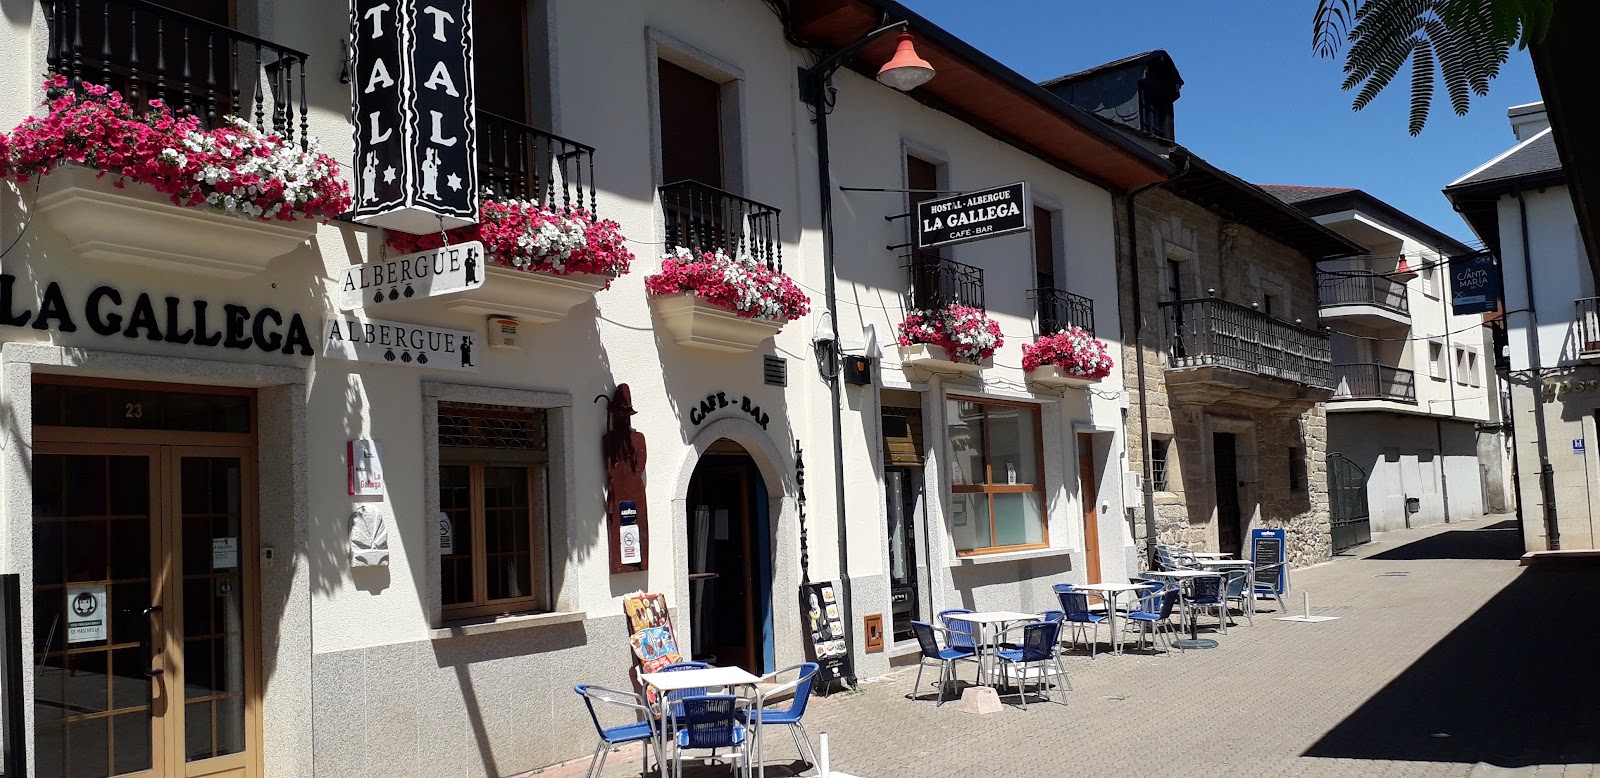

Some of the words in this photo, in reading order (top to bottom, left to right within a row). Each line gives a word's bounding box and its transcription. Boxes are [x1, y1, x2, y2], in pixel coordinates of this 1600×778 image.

[923, 217, 944, 232] LA
[946, 202, 1020, 227] GALLEGA
[931, 200, 962, 214] HOSTAL
[967, 190, 1011, 207] ALBERGUE
[975, 225, 993, 234] BAR
[343, 249, 461, 292] ALBERGUE
[0, 274, 77, 332] LA
[85, 286, 315, 356] GALLEGA
[329, 319, 456, 353] ALBERGUE
[125, 403, 143, 418] 23
[690, 392, 729, 426] CAFE
[741, 396, 770, 430] BAR
[373, 472, 381, 480] La
